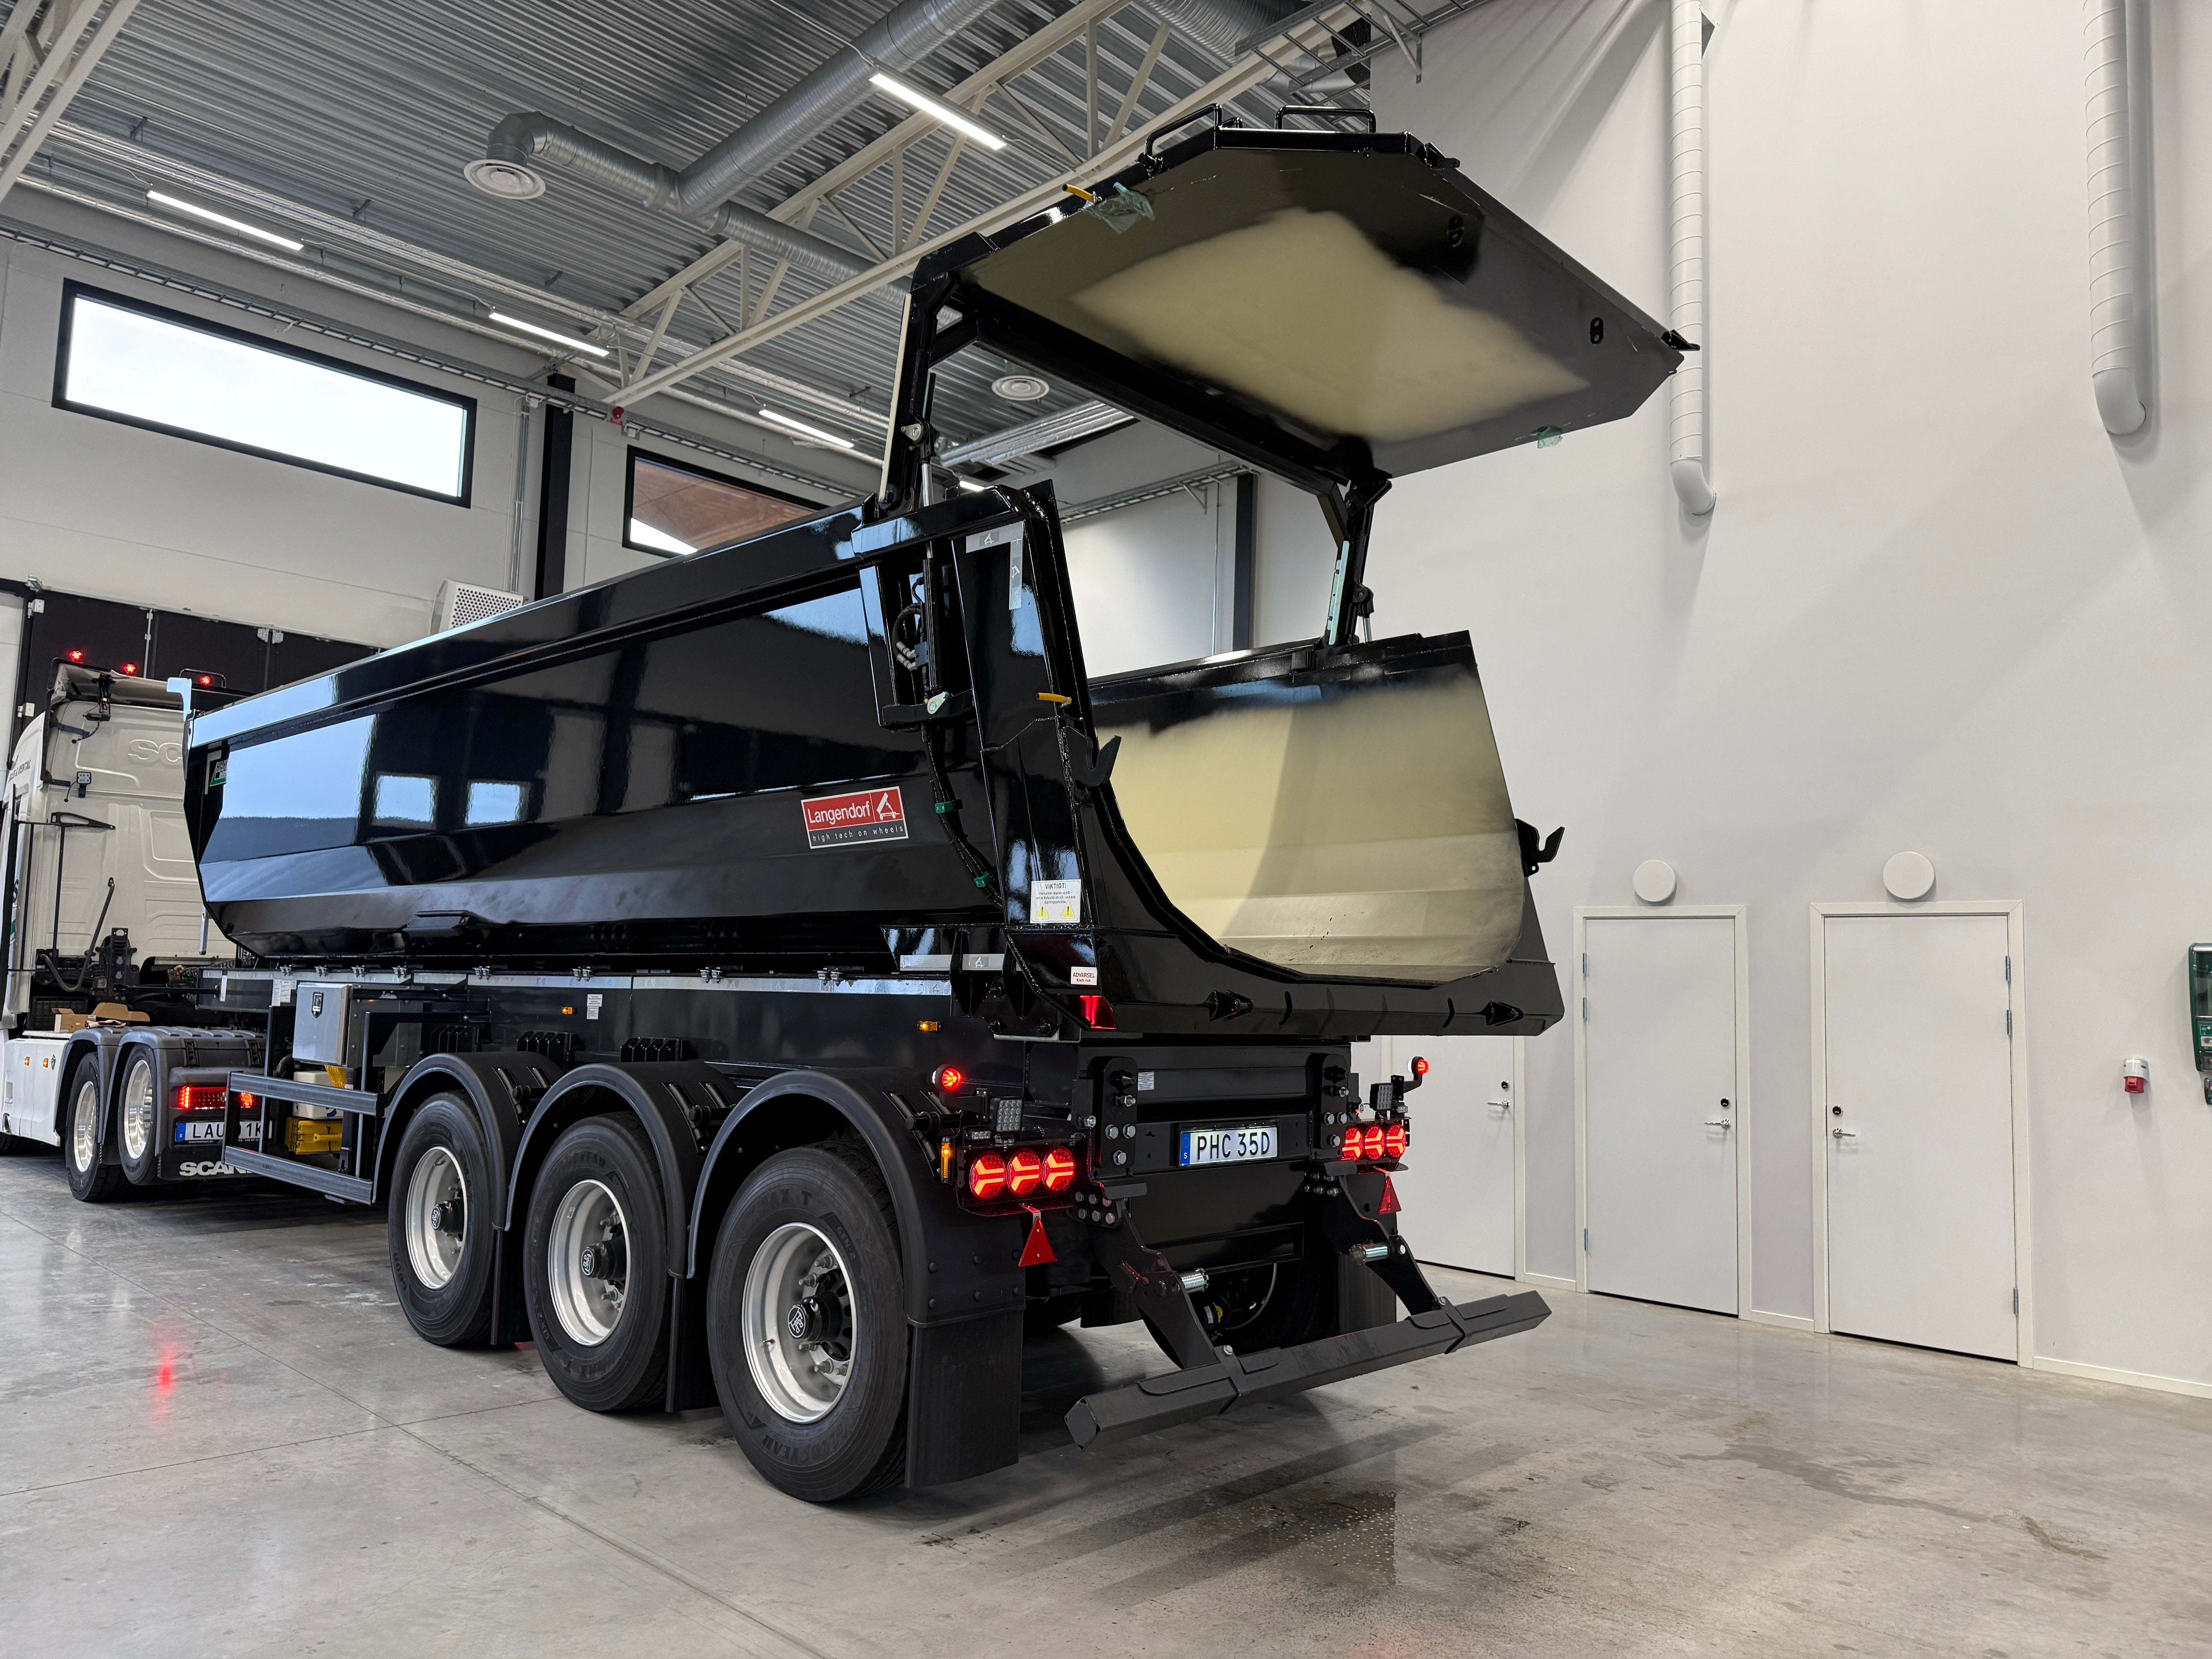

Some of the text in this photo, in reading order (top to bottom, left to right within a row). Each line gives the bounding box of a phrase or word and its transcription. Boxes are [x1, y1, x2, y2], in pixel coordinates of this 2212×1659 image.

[807, 800, 871, 825] Langendorf
[812, 833, 830, 842] high
[835, 831, 853, 840] tech
[872, 825, 903, 835] wheels
[193, 1122, 261, 1139] LAU 1K
[1197, 1131, 1270, 1160] PHC 35D
